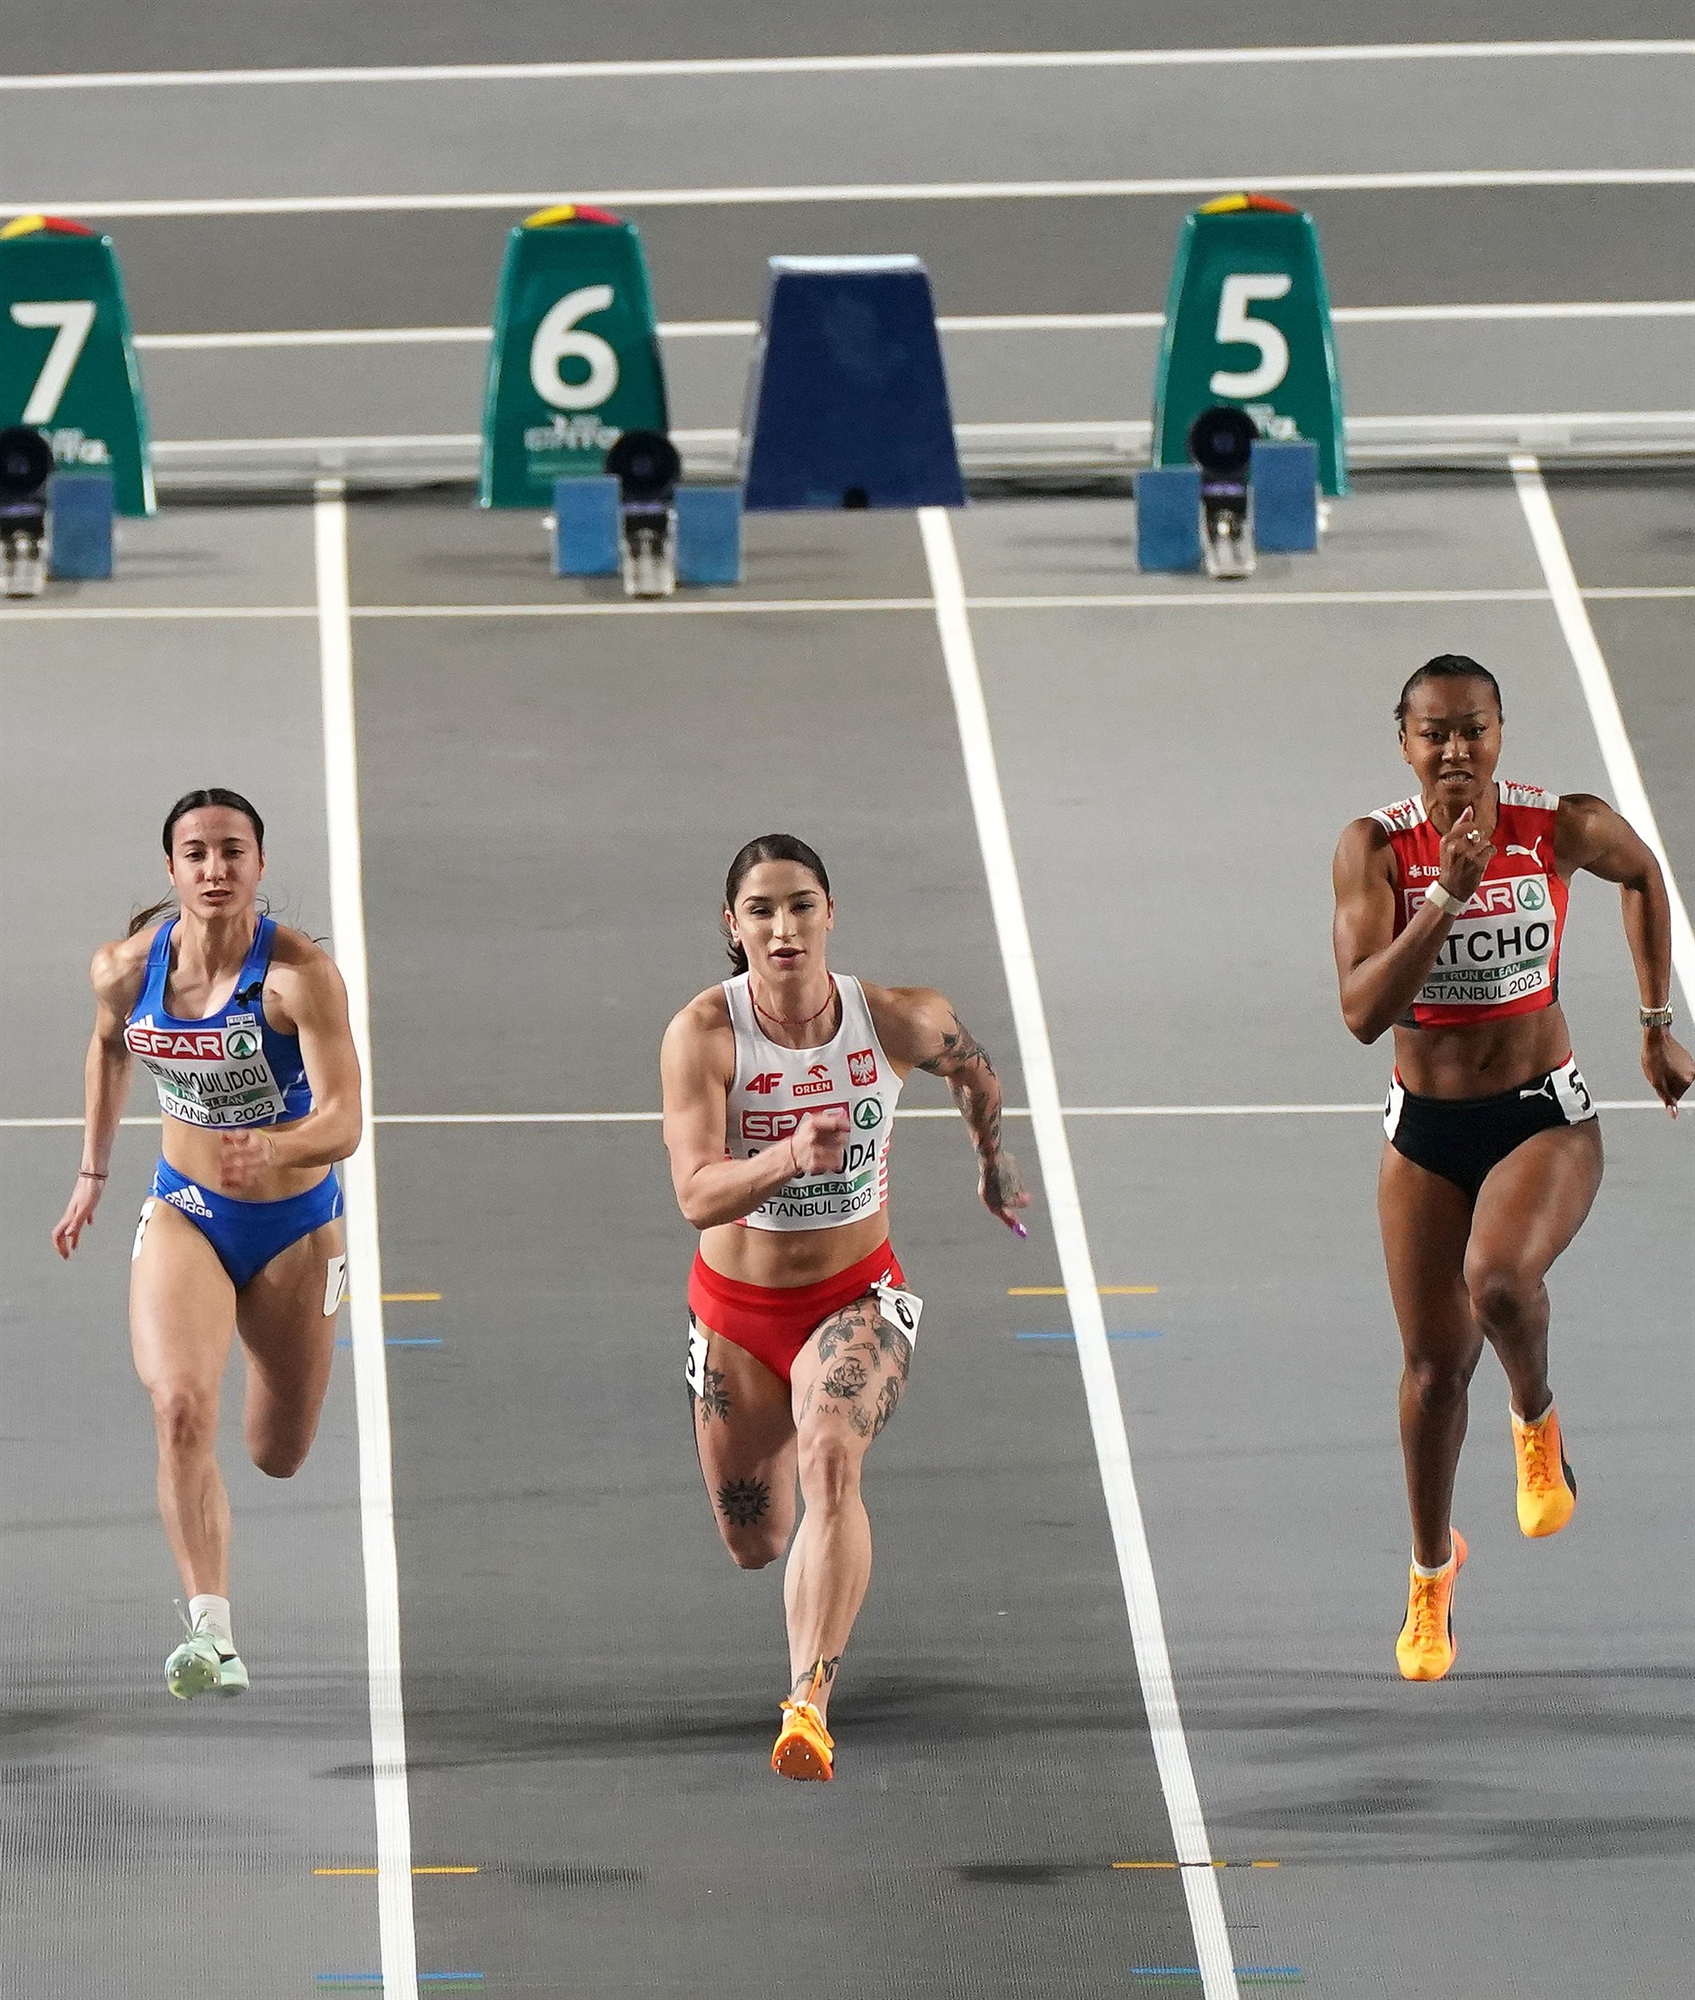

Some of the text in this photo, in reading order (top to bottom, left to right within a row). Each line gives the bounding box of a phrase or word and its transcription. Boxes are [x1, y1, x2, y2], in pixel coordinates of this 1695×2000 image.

[530, 284, 620, 411] 6
[1210, 273, 1292, 398] 5
[10, 301, 97, 425] 7
[1422, 866, 1441, 877] UB
[1436, 922, 1550, 966] TCHO
[1422, 971, 1542, 1001] ISTANBUL 2023
[1449, 970, 1479, 981] RUN
[1482, 963, 1521, 980] CLEAN
[129, 1030, 222, 1057] SPAR
[745, 1073, 783, 1094] 4F
[795, 1082, 831, 1095] ORLEN
[1569, 1069, 1591, 1111] 5
[165, 1095, 276, 1125] ISTANBUL 2023
[757, 1187, 872, 1217] STANBUL 2023
[781, 1181, 855, 1198] RUN CLEAN
[165, 1193, 214, 1219] adidas
